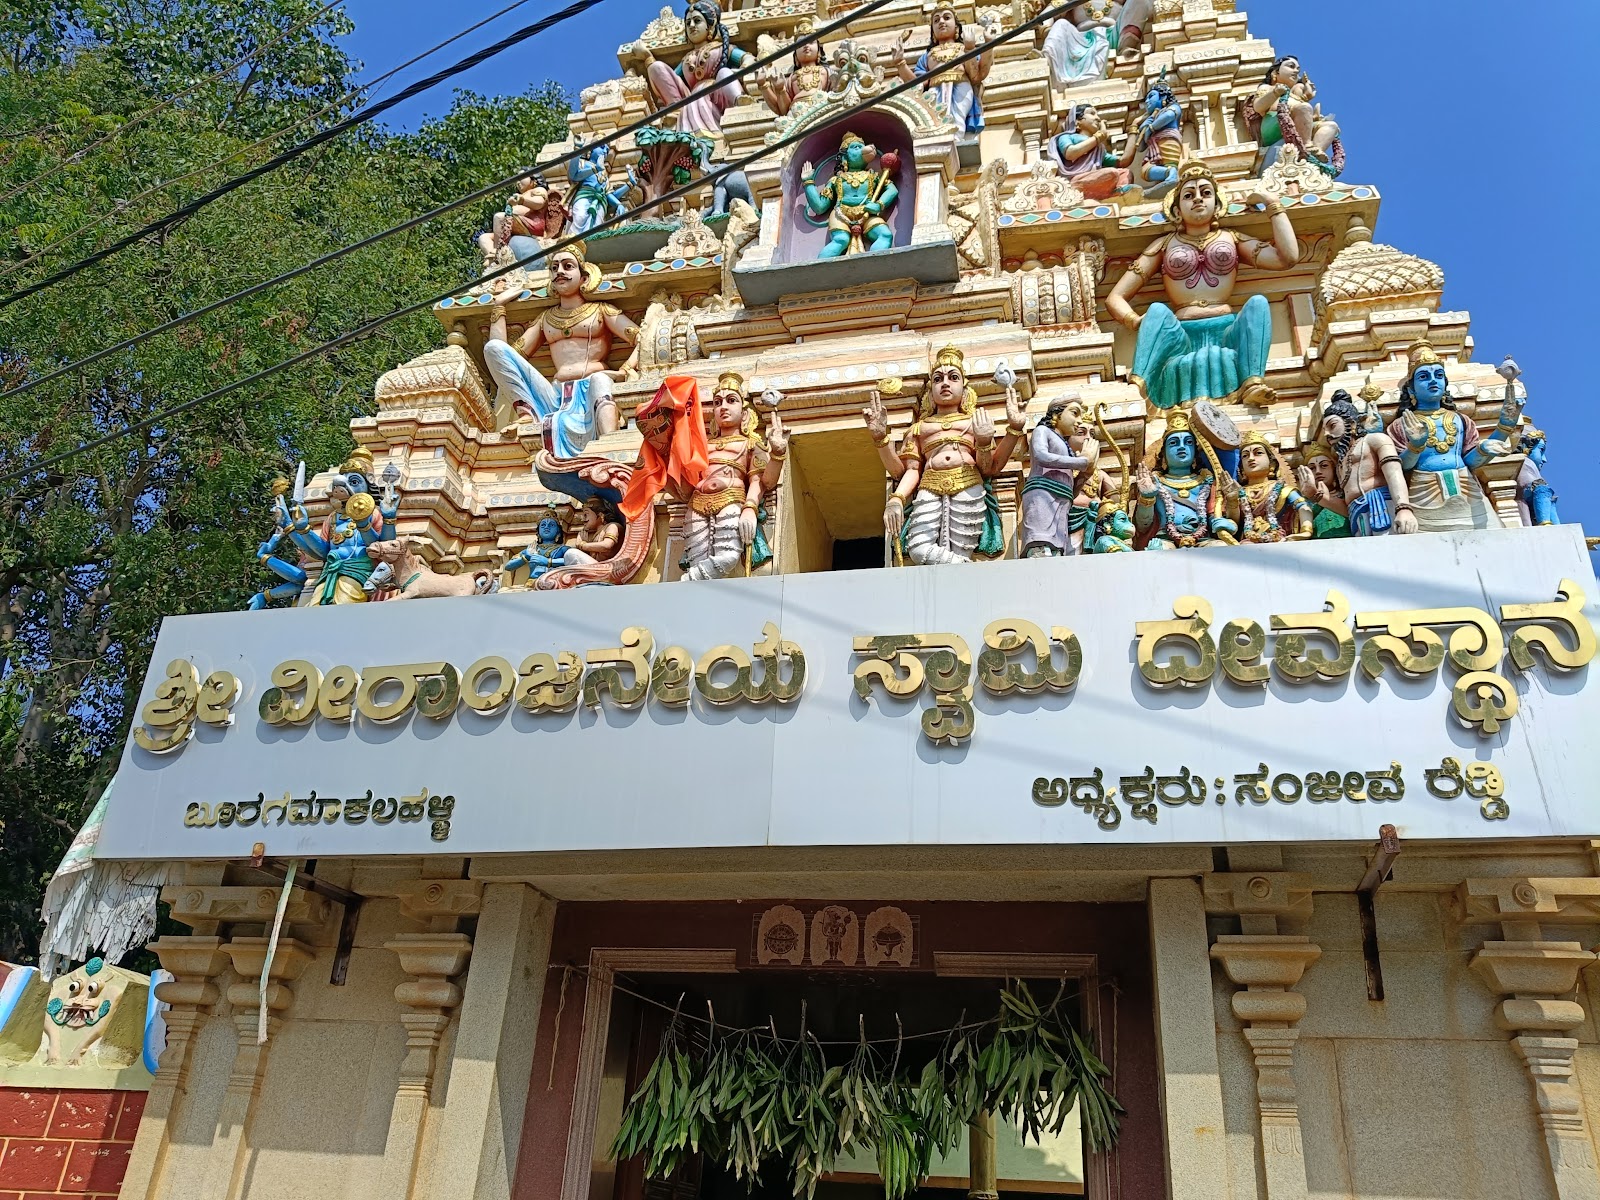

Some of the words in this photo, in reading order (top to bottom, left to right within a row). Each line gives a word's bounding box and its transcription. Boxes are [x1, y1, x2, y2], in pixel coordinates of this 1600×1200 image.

[133, 658, 240, 754] ಶ್ರೀ
[259, 621, 806, 722] ವೀರಾಂಜನೇಯ
[852, 618, 1083, 742] ಸ್ವಾಮಿ
[1136, 578, 1597, 734] ದೇವಸ್ಥಾನ
[1424, 756, 1510, 821] ರೆಡ್ಡಿ
